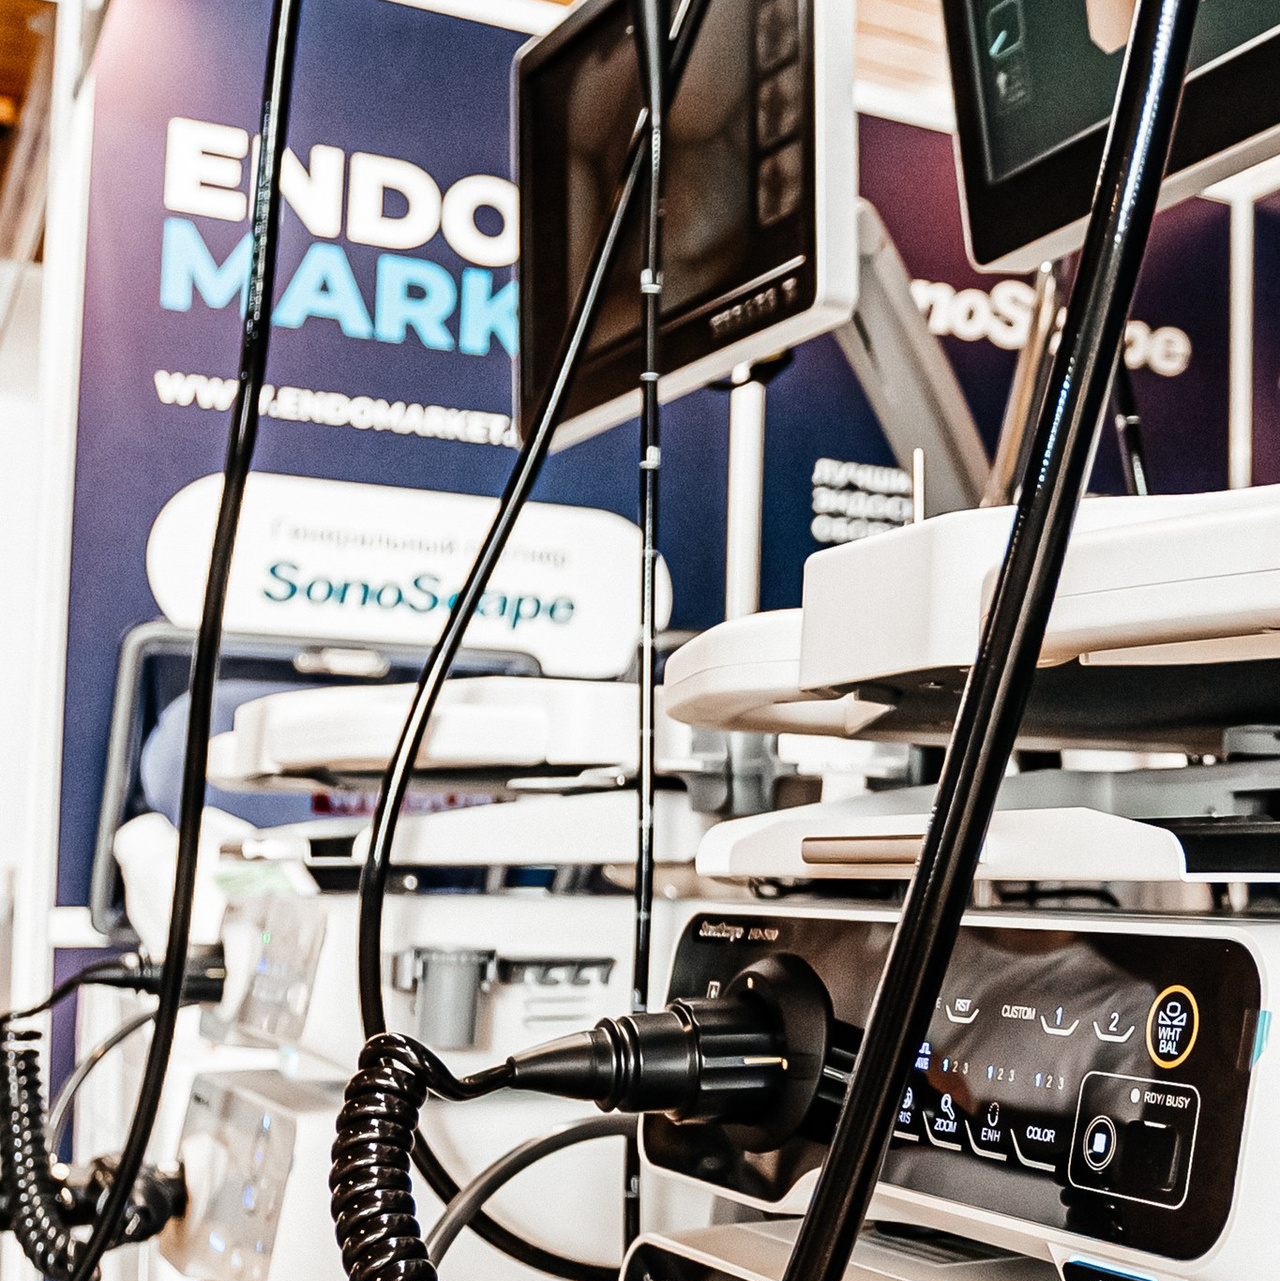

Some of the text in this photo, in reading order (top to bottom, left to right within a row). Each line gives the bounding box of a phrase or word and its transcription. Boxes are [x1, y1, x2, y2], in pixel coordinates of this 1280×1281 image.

[163, 117, 519, 267] ENDO
[160, 217, 519, 356] MARK
[262, 560, 577, 630] SonoSape
[954, 998, 971, 1012] RST
[1001, 1004, 1119, 1031] CUSTOM 1 2
[1158, 1027, 1182, 1042] WHT
[1159, 1040, 1178, 1055] BAL
[942, 1057, 968, 1075] 1 2 3
[987, 1064, 1015, 1082] 1 2 3
[1034, 1072, 1064, 1090] 1 2 3
[899, 1110, 912, 1124] RIS
[934, 1117, 957, 1133] ZOOM
[980, 1127, 1000, 1142] ENH
[1026, 1125, 1056, 1144] COLOR
